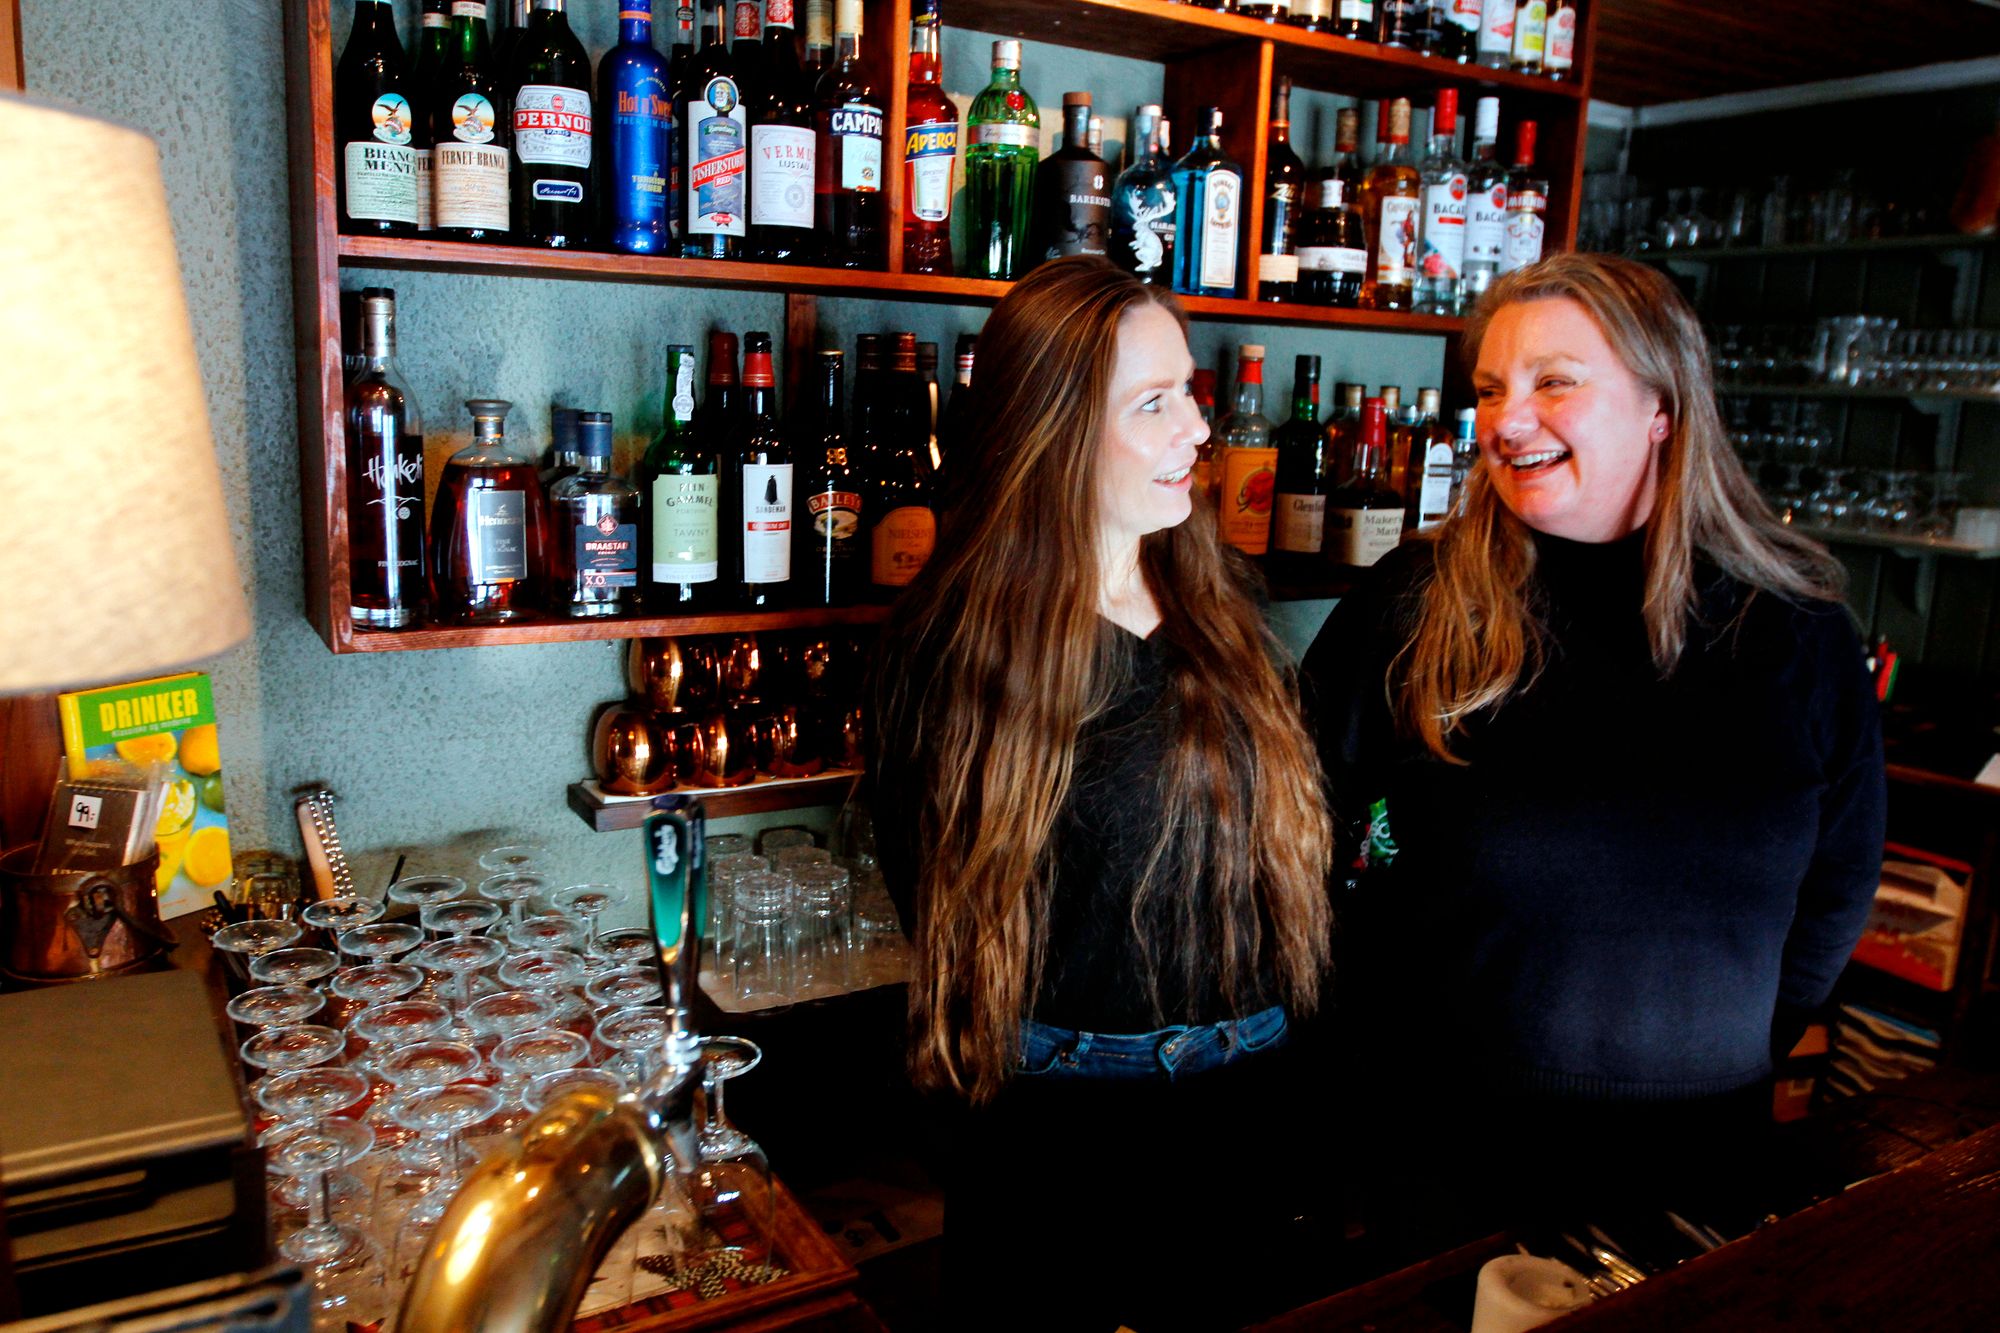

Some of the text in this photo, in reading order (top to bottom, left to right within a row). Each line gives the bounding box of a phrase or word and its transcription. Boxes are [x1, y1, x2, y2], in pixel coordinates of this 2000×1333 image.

[618, 91, 640, 113] Hot
[516, 112, 592, 133] PERNOD
[905, 132, 957, 156] APEROL
[811, 494, 861, 510] BAILEYS
[673, 529, 711, 537] TAWNY
[100, 688, 199, 732] DRINKER
